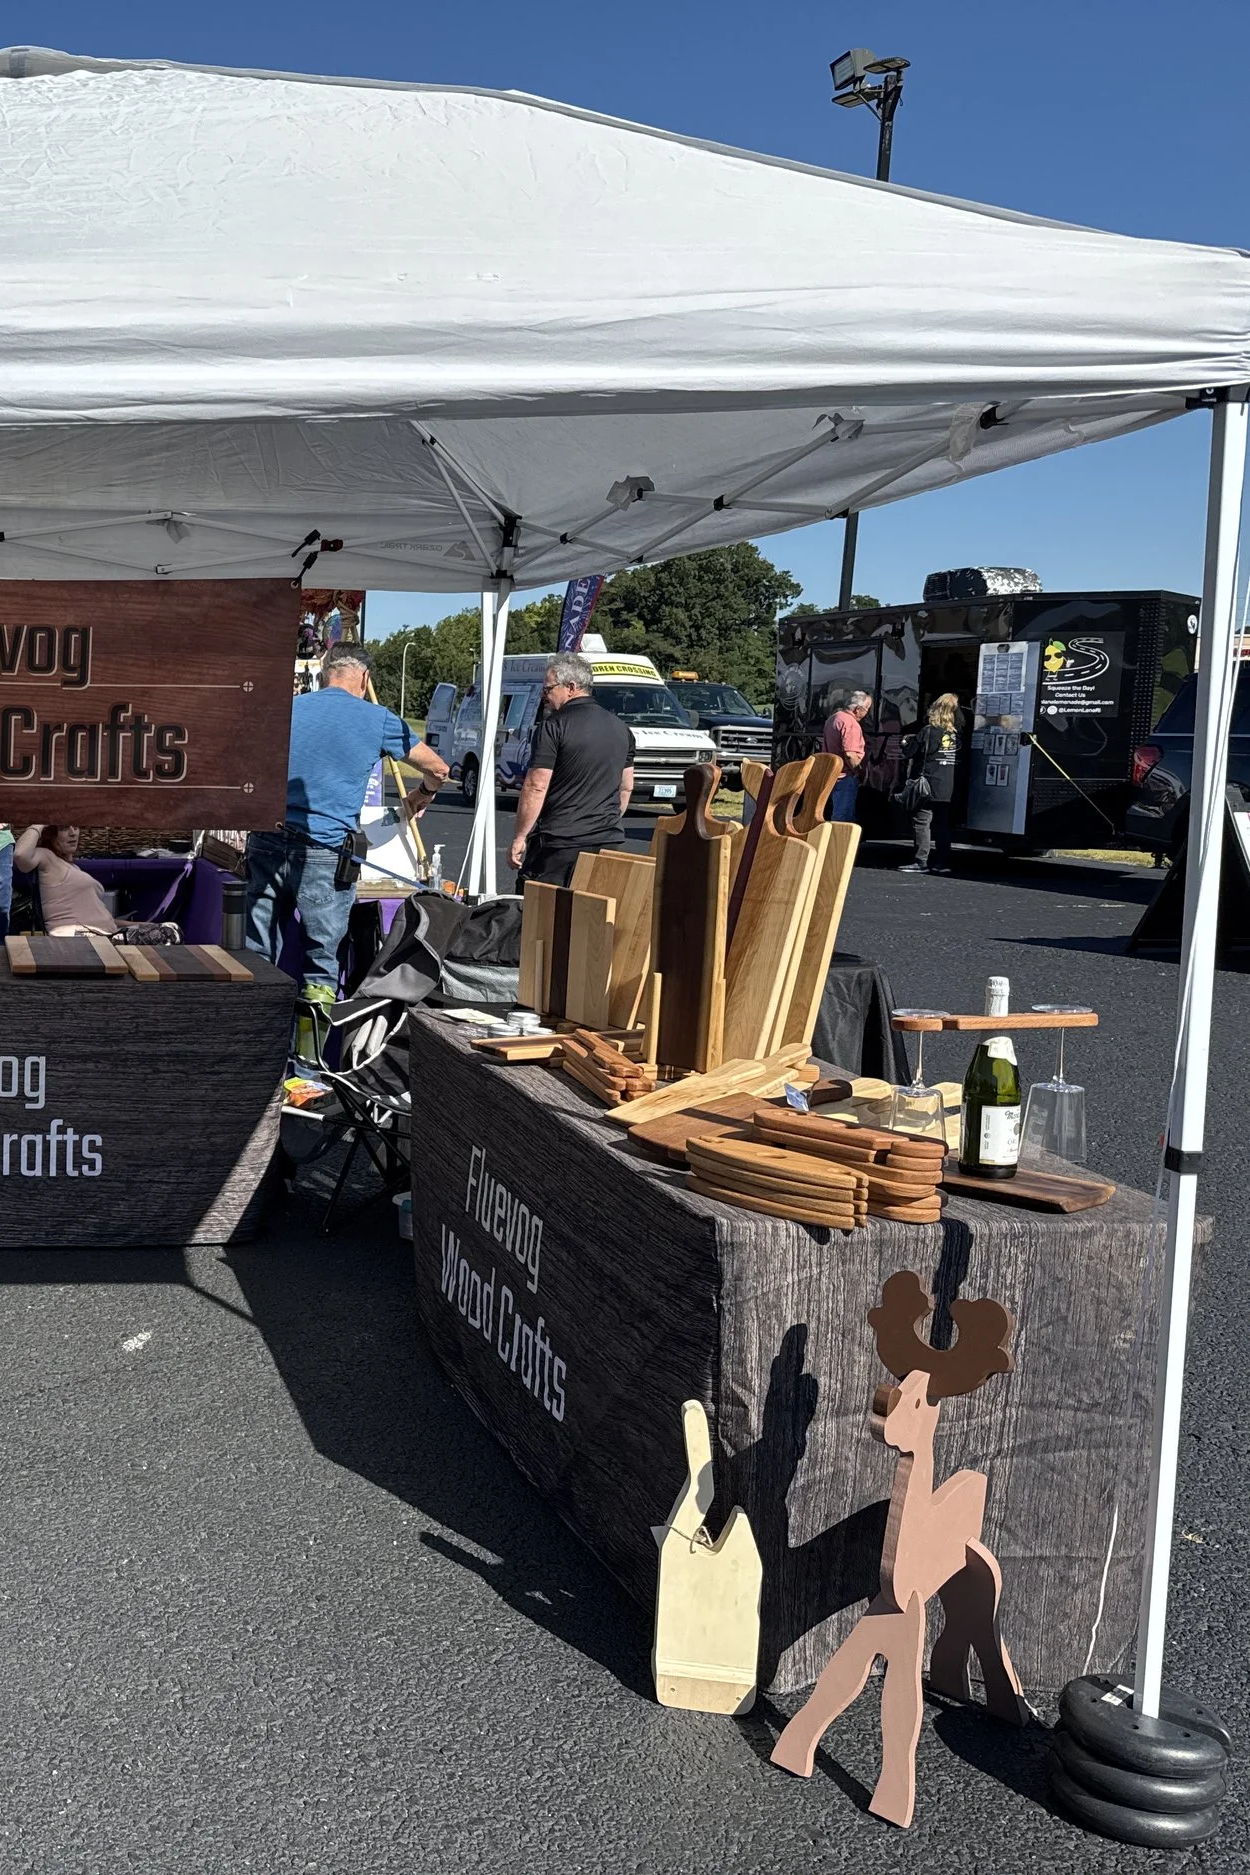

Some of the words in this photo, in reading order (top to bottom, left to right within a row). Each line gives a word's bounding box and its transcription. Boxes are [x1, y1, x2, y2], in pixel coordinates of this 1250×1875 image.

[564, 578, 590, 655] NADE
[591, 664, 615, 673] DREN
[616, 665, 657, 677] CROSSING
[0, 702, 190, 783] Crafts
[465, 1145, 544, 1294] Fluevog
[441, 1223, 496, 1345] Wood
[497, 1284, 567, 1423] Crafts
